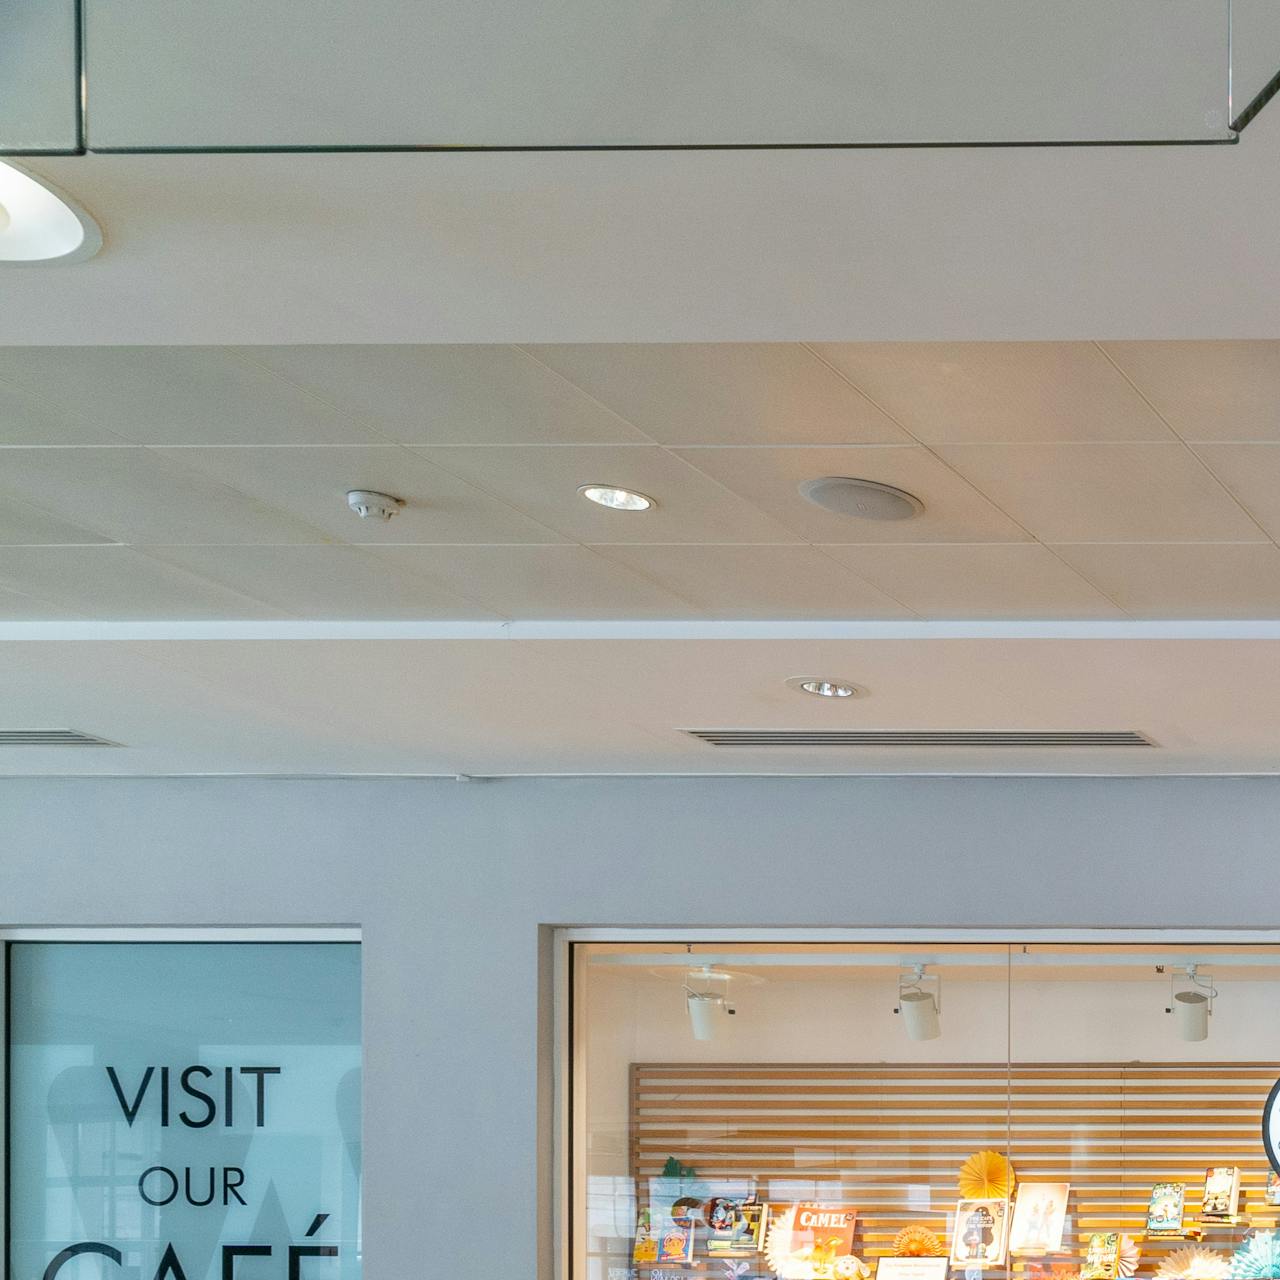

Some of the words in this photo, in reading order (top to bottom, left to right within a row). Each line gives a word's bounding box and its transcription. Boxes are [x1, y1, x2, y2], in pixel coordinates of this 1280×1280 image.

[106, 1065, 281, 1129] VISIT
[138, 1166, 247, 1206] OUR
[799, 1211, 849, 1228] CAMEL
